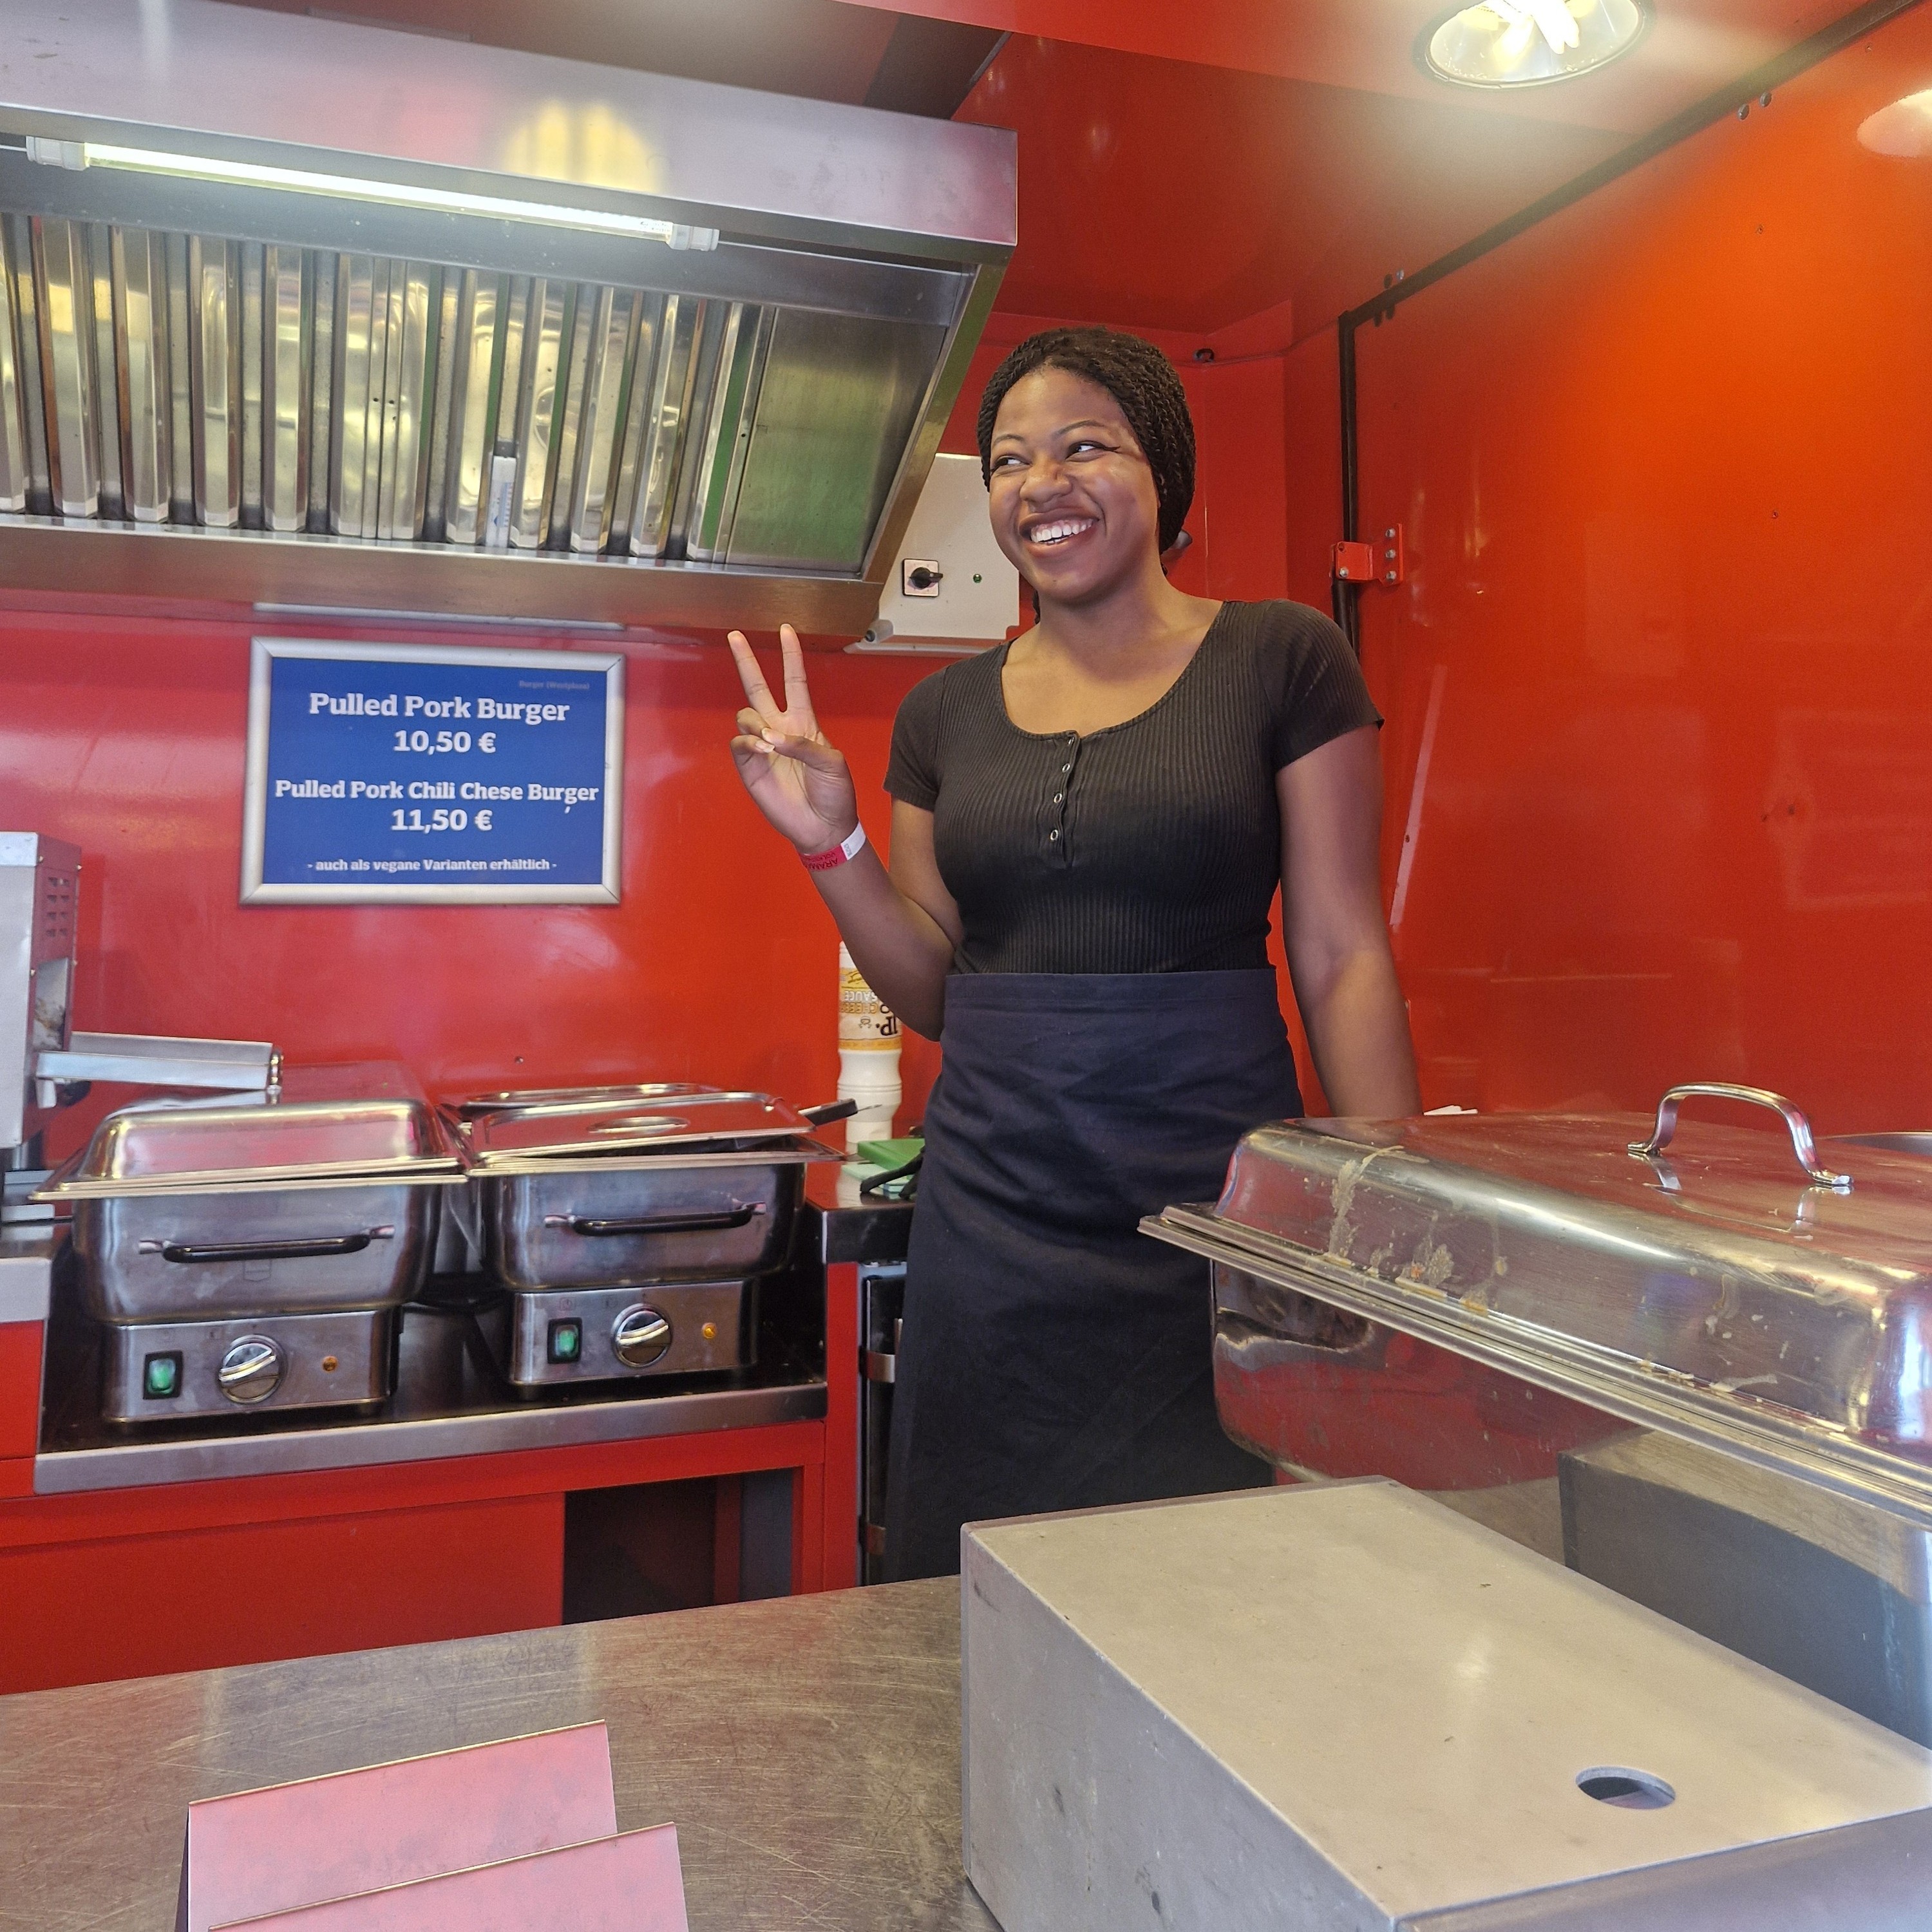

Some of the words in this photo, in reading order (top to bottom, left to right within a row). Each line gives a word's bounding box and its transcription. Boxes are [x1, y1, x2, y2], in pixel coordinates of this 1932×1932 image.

[309, 692, 398, 716] Pulled
[404, 696, 471, 718] Pork
[477, 698, 570, 726] Burger
[394, 730, 471, 755] 10,50
[478, 732, 496, 753] €
[275, 779, 346, 798] Pulled
[350, 781, 404, 799] Pork
[408, 781, 456, 799] Chili
[460, 782, 524, 800] Chese
[527, 784, 600, 804] Burger
[392, 809, 468, 834] 11,50
[475, 810, 493, 831] €
[316, 858, 348, 871] auch
[350, 859, 370, 871] als
[373, 861, 421, 873] vegane
[423, 859, 488, 871] Varianten
[489, 858, 550, 870] erhältlich
[844, 990, 878, 1001] SAUCE
